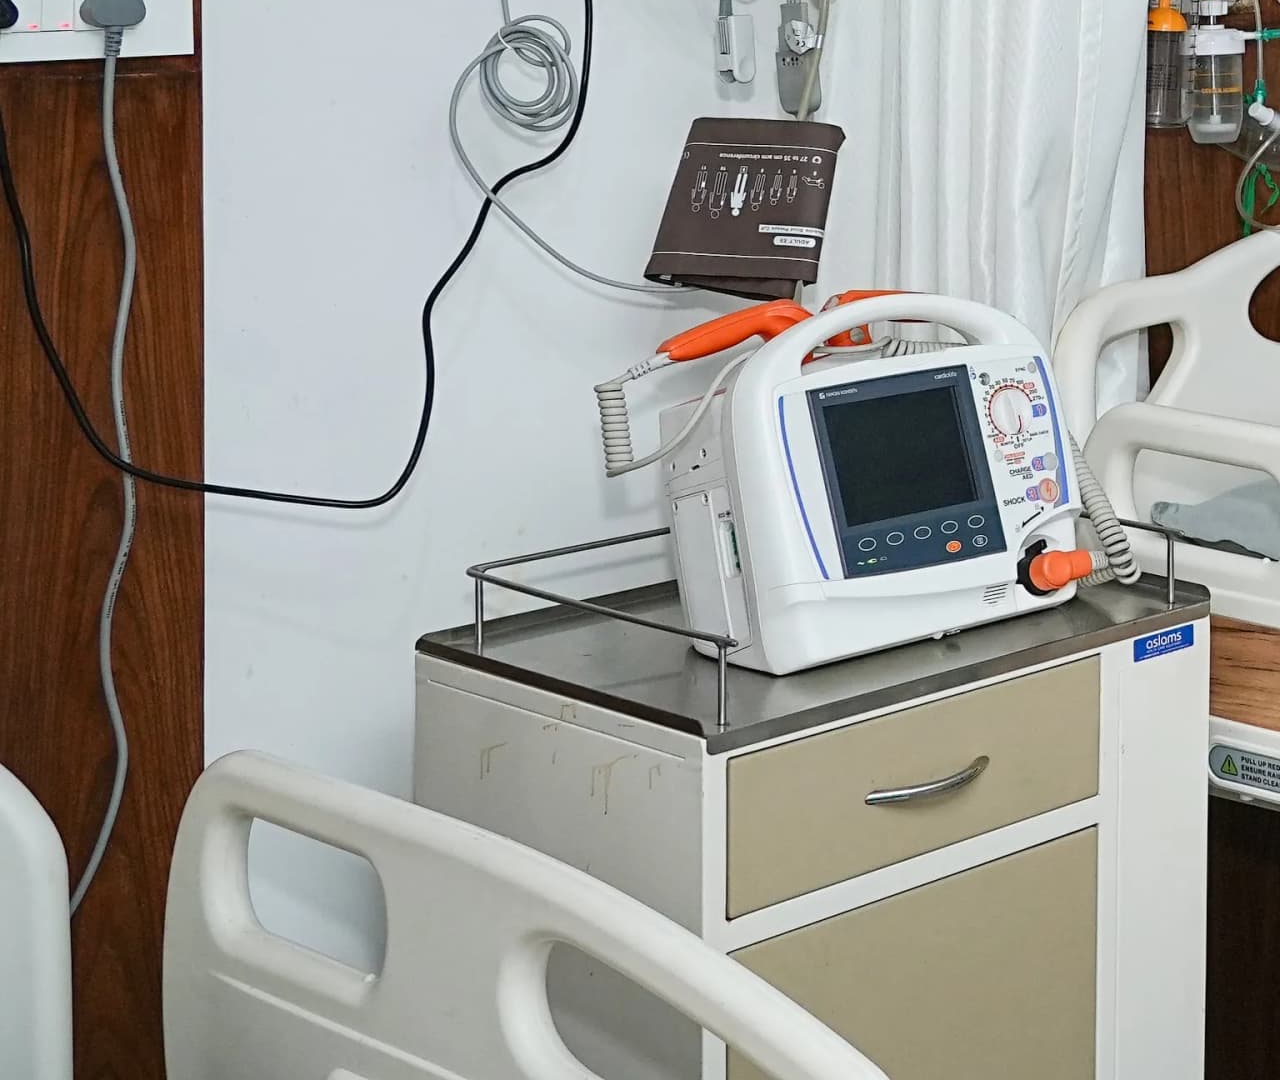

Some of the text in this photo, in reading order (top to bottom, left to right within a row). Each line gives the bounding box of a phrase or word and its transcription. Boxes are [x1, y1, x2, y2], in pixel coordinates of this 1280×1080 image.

[1009, 466, 1032, 475] CHARGE
[1003, 496, 1026, 507] SHOCK
[1241, 755, 1258, 766] PULL
[1258, 758, 1266, 767] UP
[1268, 760, 1280, 771] RED
[1241, 764, 1265, 777] ENSURE
[1267, 770, 1280, 781] RAIL
[1241, 773, 1262, 784] STAND
